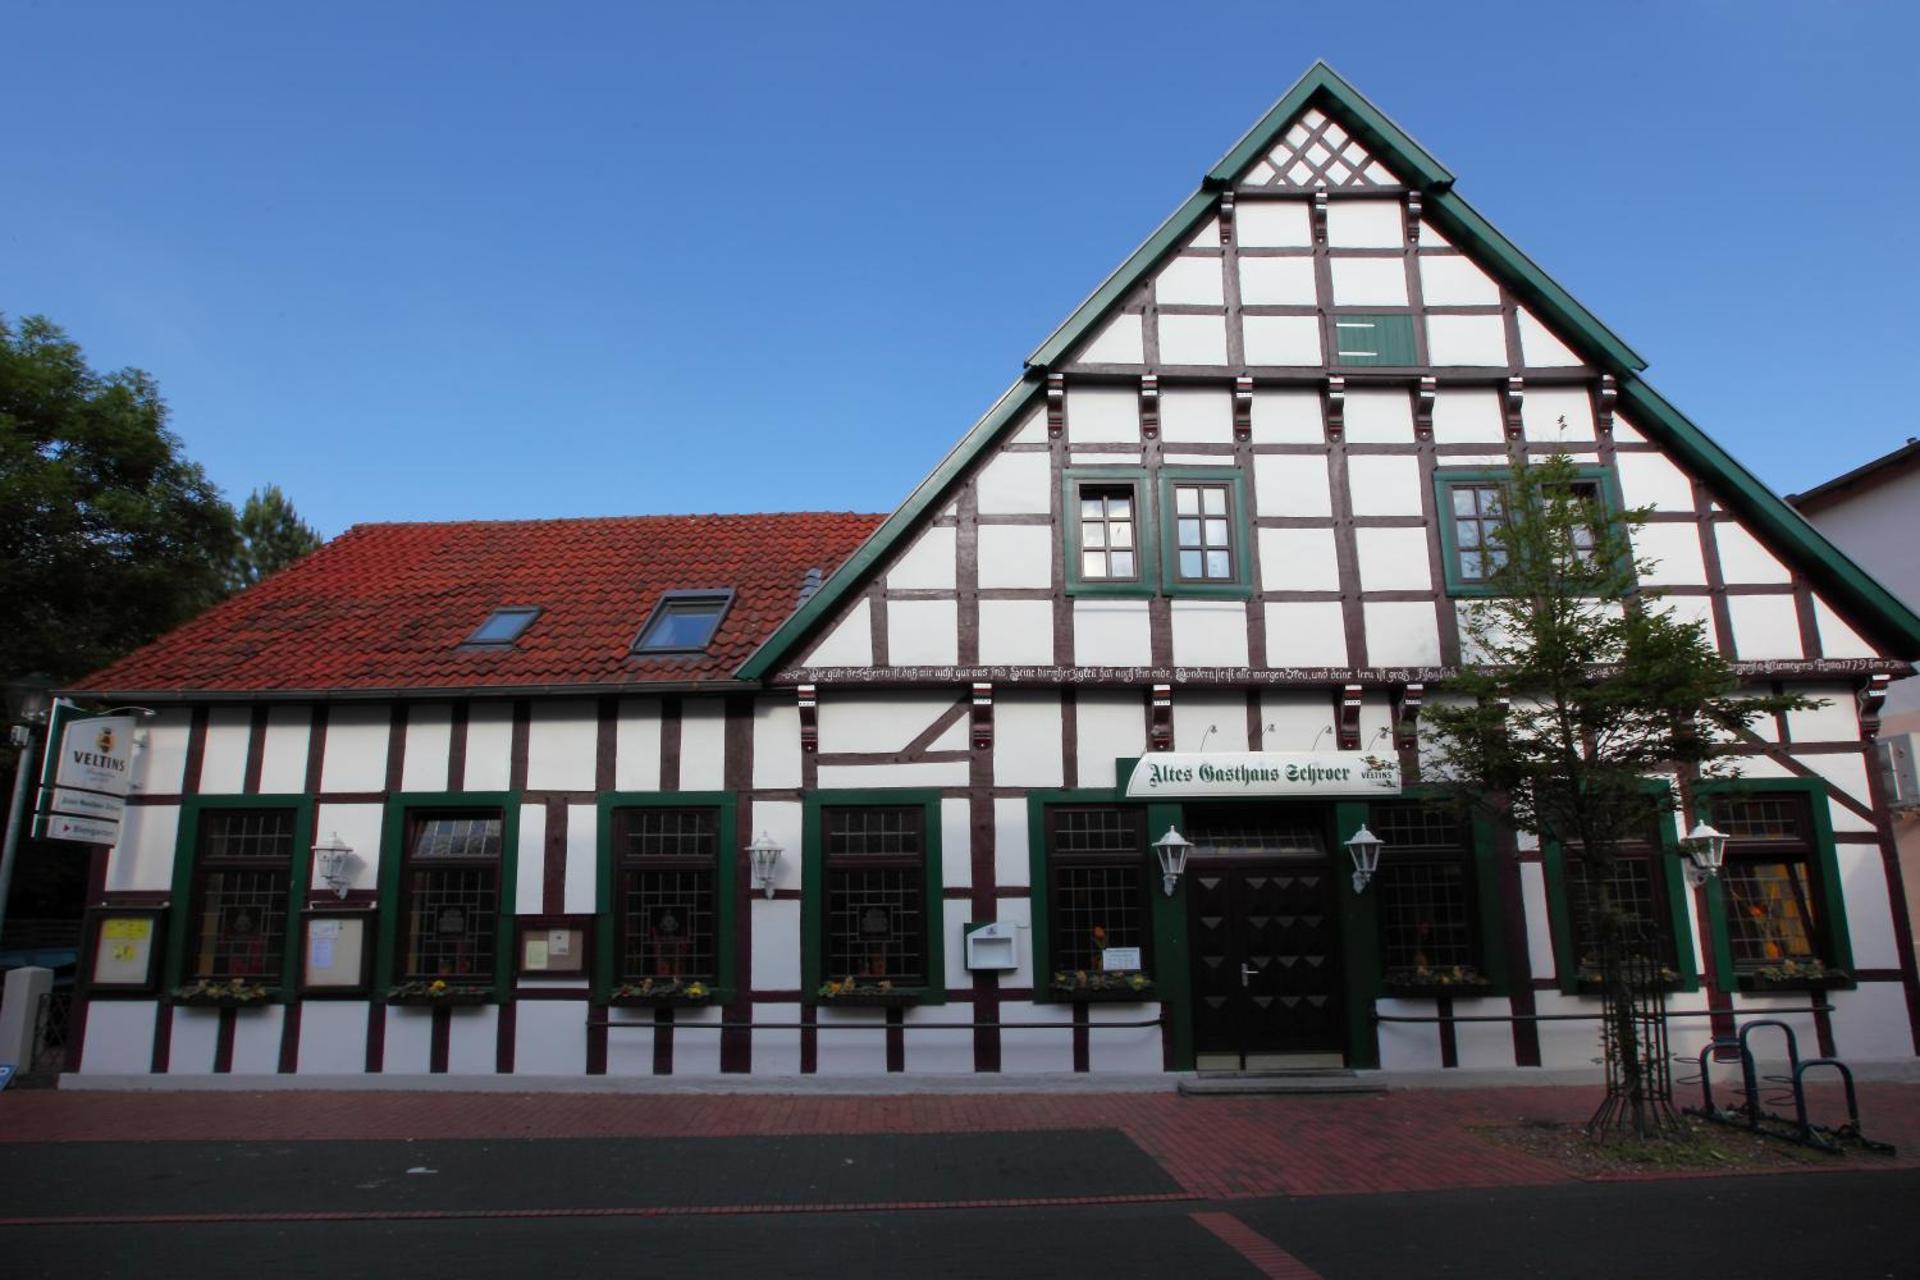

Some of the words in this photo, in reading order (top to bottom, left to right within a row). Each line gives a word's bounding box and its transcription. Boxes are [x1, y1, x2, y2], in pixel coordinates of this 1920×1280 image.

[74, 751, 126, 772] VELTINS
[1150, 763, 1193, 787] Altes
[1199, 763, 1279, 786] Gasthaus
[1286, 763, 1350, 786] Schroer
